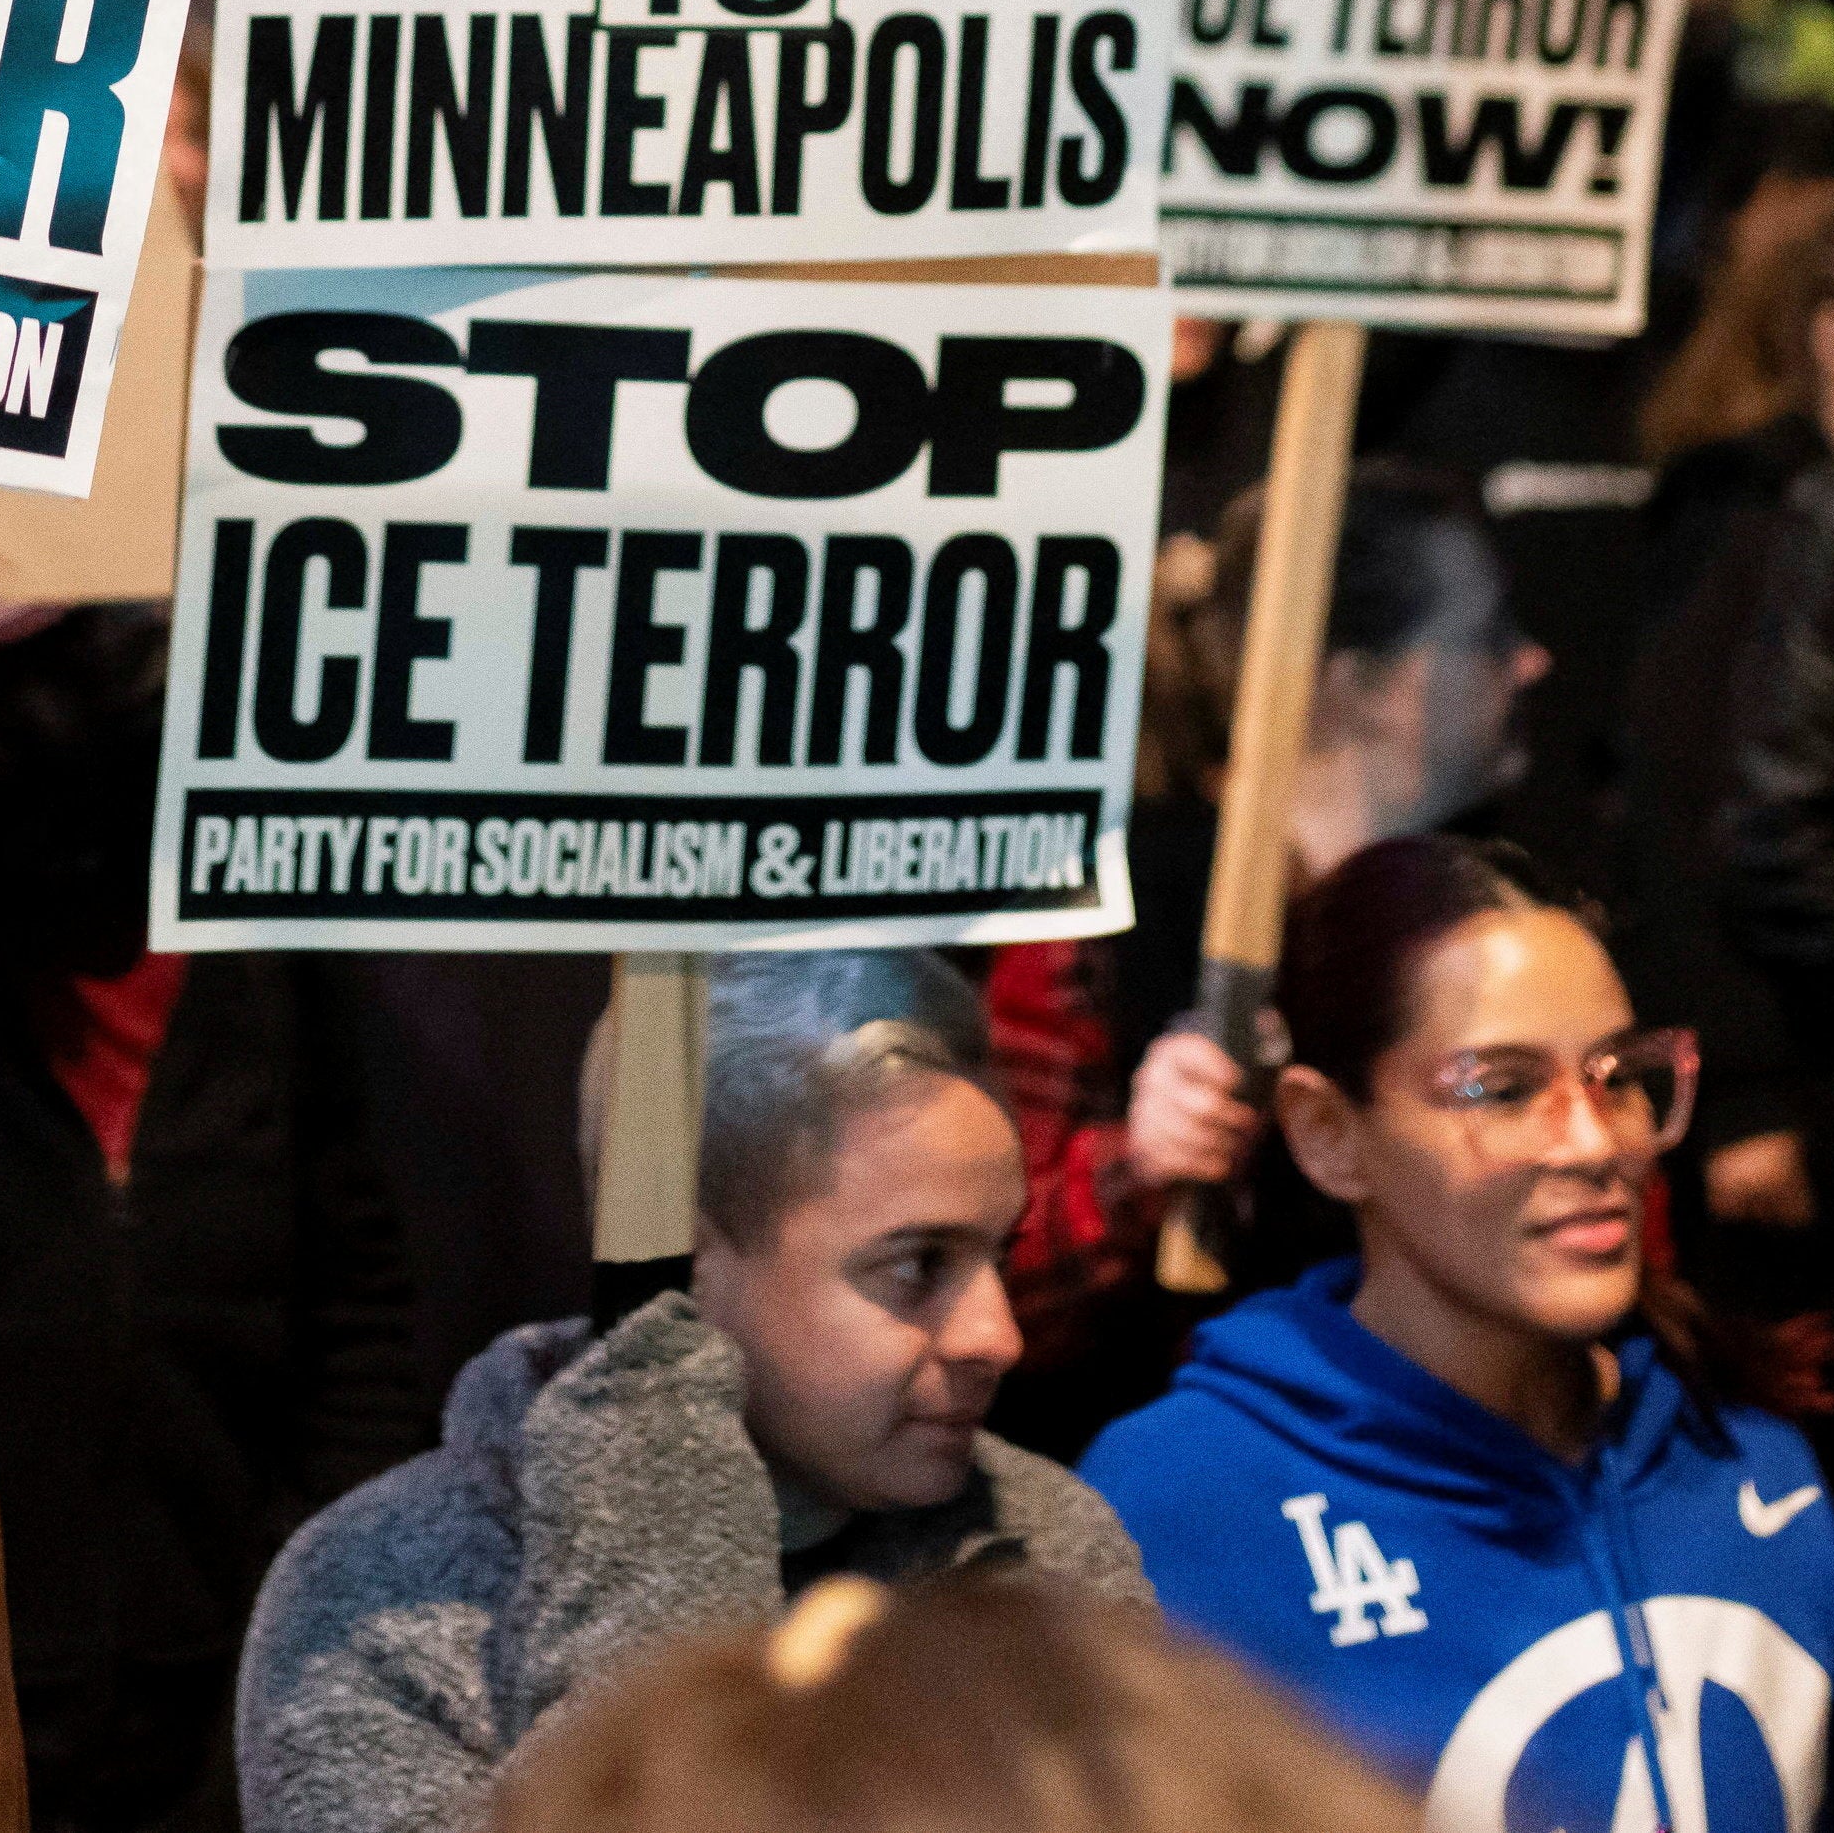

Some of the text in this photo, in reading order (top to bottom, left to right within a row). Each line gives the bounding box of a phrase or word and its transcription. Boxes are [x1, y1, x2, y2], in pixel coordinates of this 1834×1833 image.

[237, 9, 1139, 224] MINNEAPOLIS
[1160, 75, 1633, 195] NOW!
[214, 309, 1147, 501] STOP
[195, 516, 1122, 768] ICE TERROR
[191, 812, 1086, 899] PARTY FOR SOCIALISM & LIBERATION
[1280, 1492, 1429, 1648] LA
